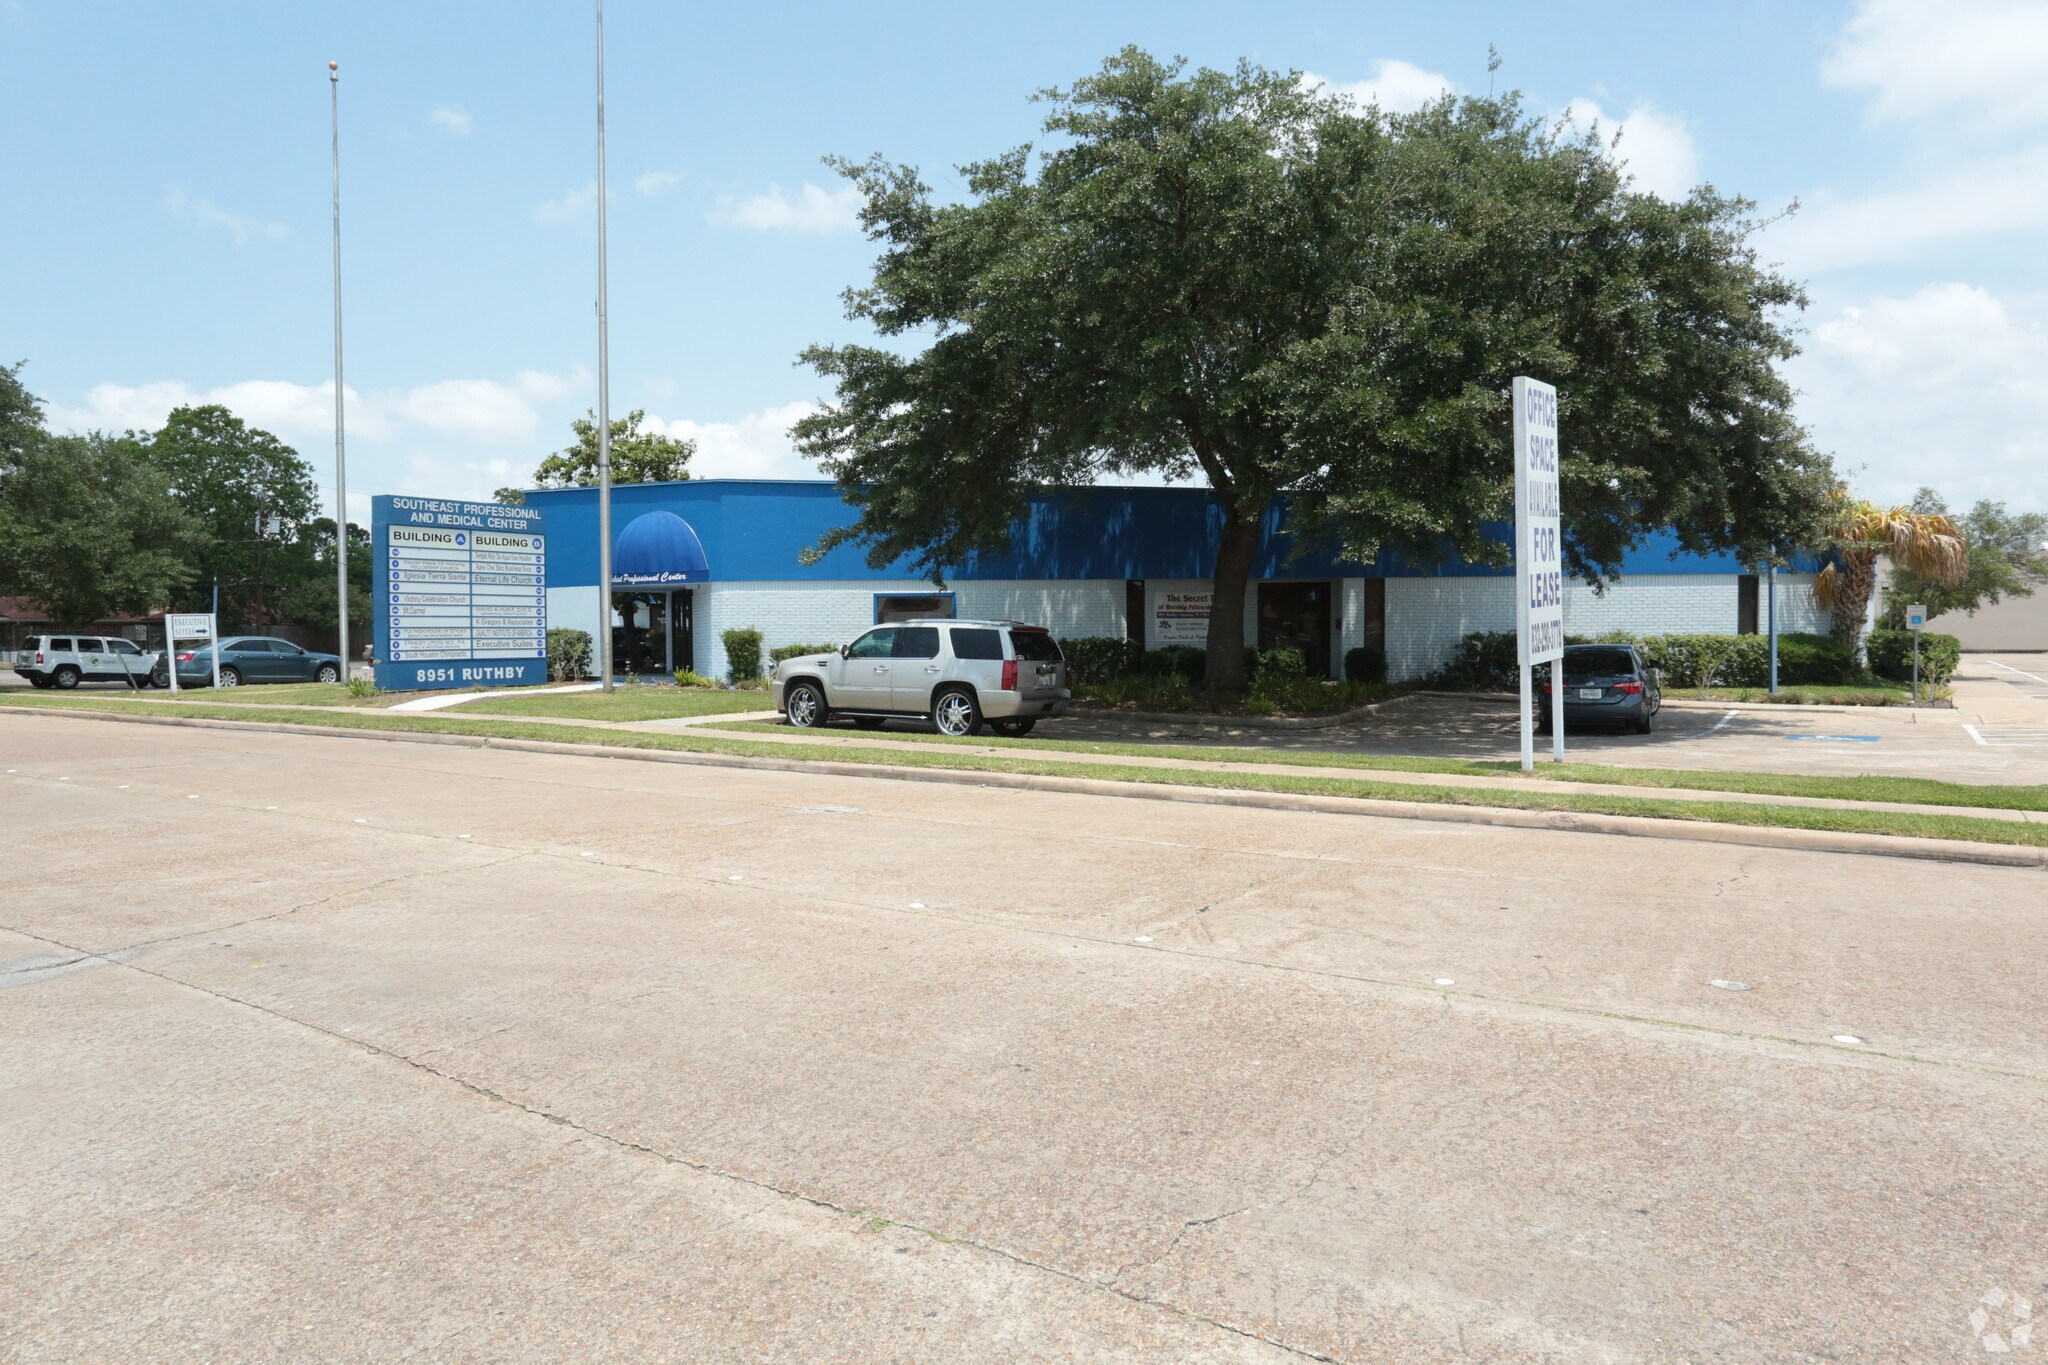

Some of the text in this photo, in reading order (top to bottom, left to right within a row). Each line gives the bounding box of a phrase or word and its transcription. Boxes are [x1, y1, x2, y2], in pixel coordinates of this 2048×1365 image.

[1527, 387, 1556, 428] OFFICE
[1530, 434, 1555, 472] SPACE
[393, 498, 541, 519] SOUTHEAST PROFESSIONAL
[410, 512, 527, 529] AND MEDICAL CENTER
[393, 531, 452, 543] BUILDING
[476, 536, 528, 547] BUILDING
[1533, 527, 1555, 562] FOR
[404, 572, 425, 580] Iglesia
[428, 572, 446, 580] Tierra
[475, 575, 496, 583] Eternal
[511, 576, 532, 584] Church
[623, 573, 660, 584] Professional
[661, 571, 687, 582] Center
[1309, 591, 1316, 601] 1
[1530, 572, 1560, 609] LEASE
[404, 595, 420, 603] Victory
[1167, 594, 1181, 602] The
[1183, 594, 1208, 602] Secret
[174, 618, 207, 626] EXECUTIVE
[175, 628, 195, 636] SUITES
[476, 640, 510, 648] Executive
[405, 651, 419, 659] South
[440, 650, 467, 658] Chiropractic
[417, 666, 524, 682] 8951 RUTHBY
